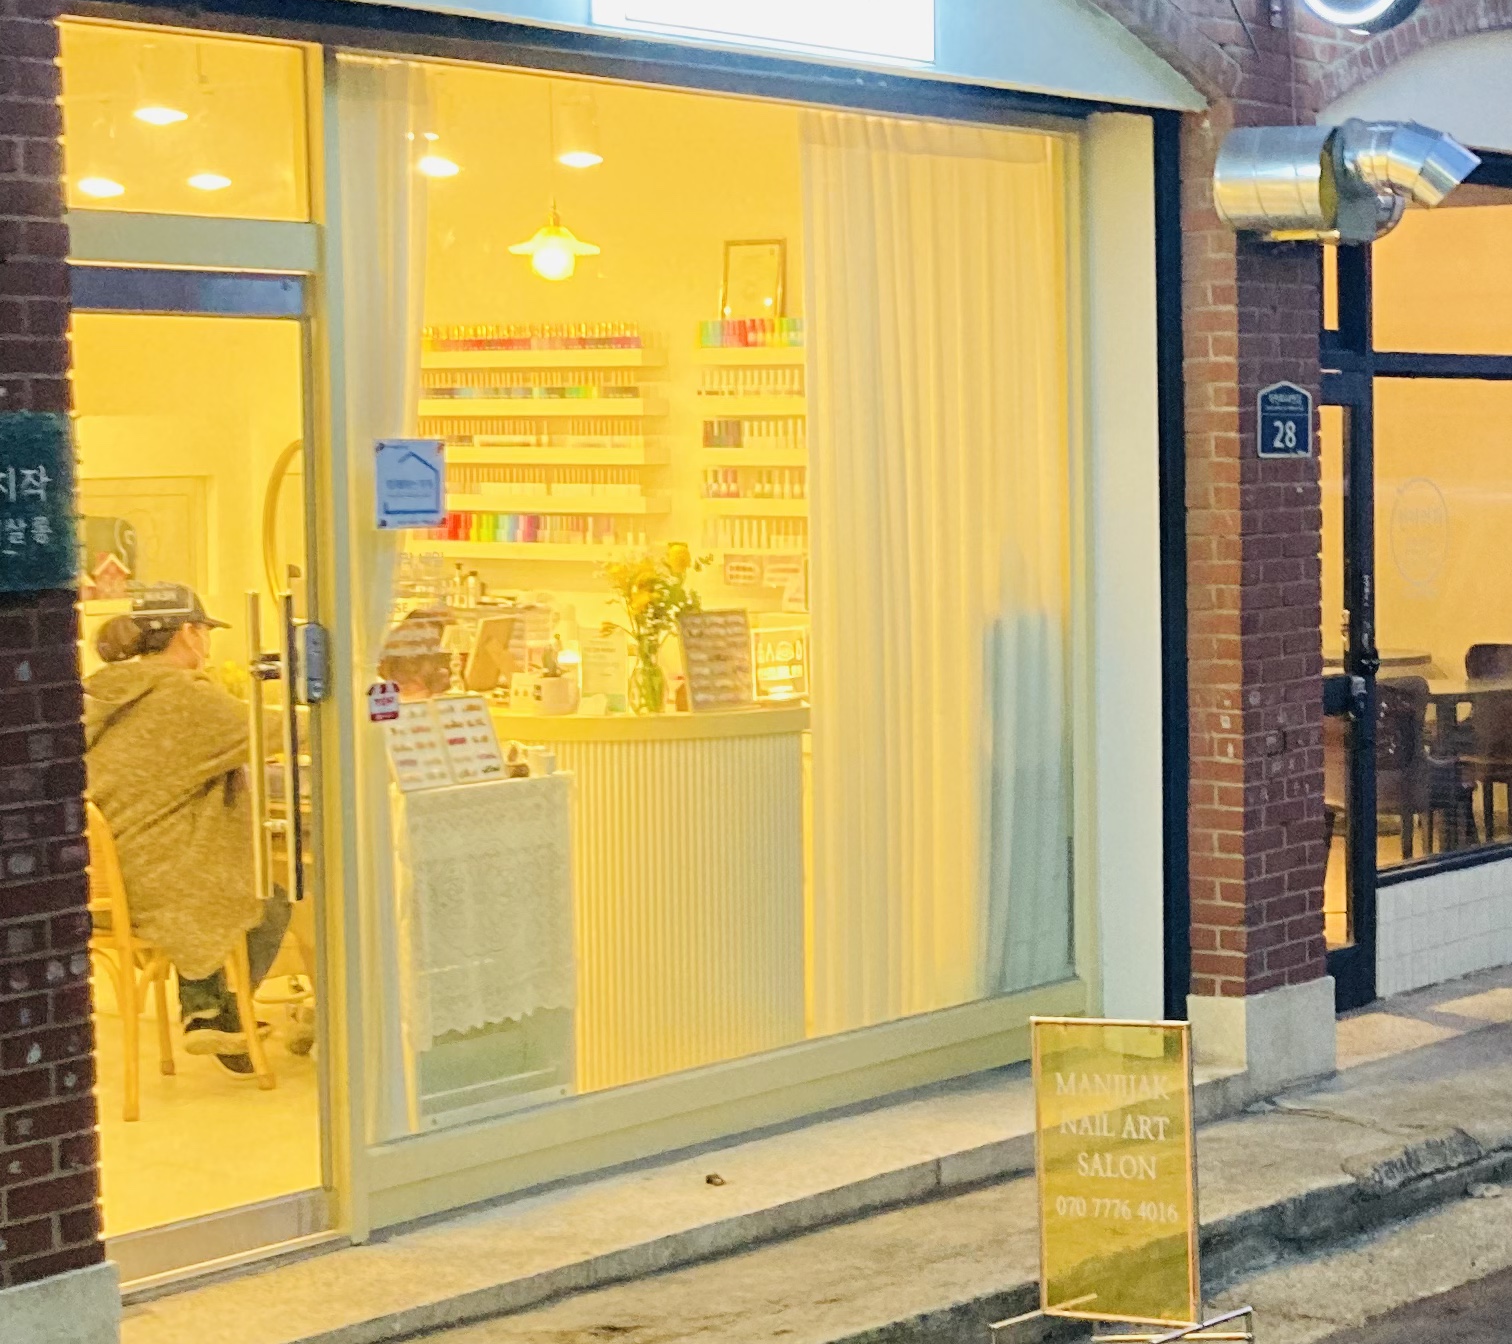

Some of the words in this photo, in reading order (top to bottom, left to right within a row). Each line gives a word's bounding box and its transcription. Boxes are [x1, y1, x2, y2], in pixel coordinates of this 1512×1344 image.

[1273, 420, 1297, 448] 28
[1060, 1109, 1116, 1138] NAIL
[1121, 1114, 1170, 1141] ART
[1077, 1152, 1157, 1180] SALON
[1055, 1195, 1087, 1217] 070
[1091, 1197, 1132, 1220] 7776
